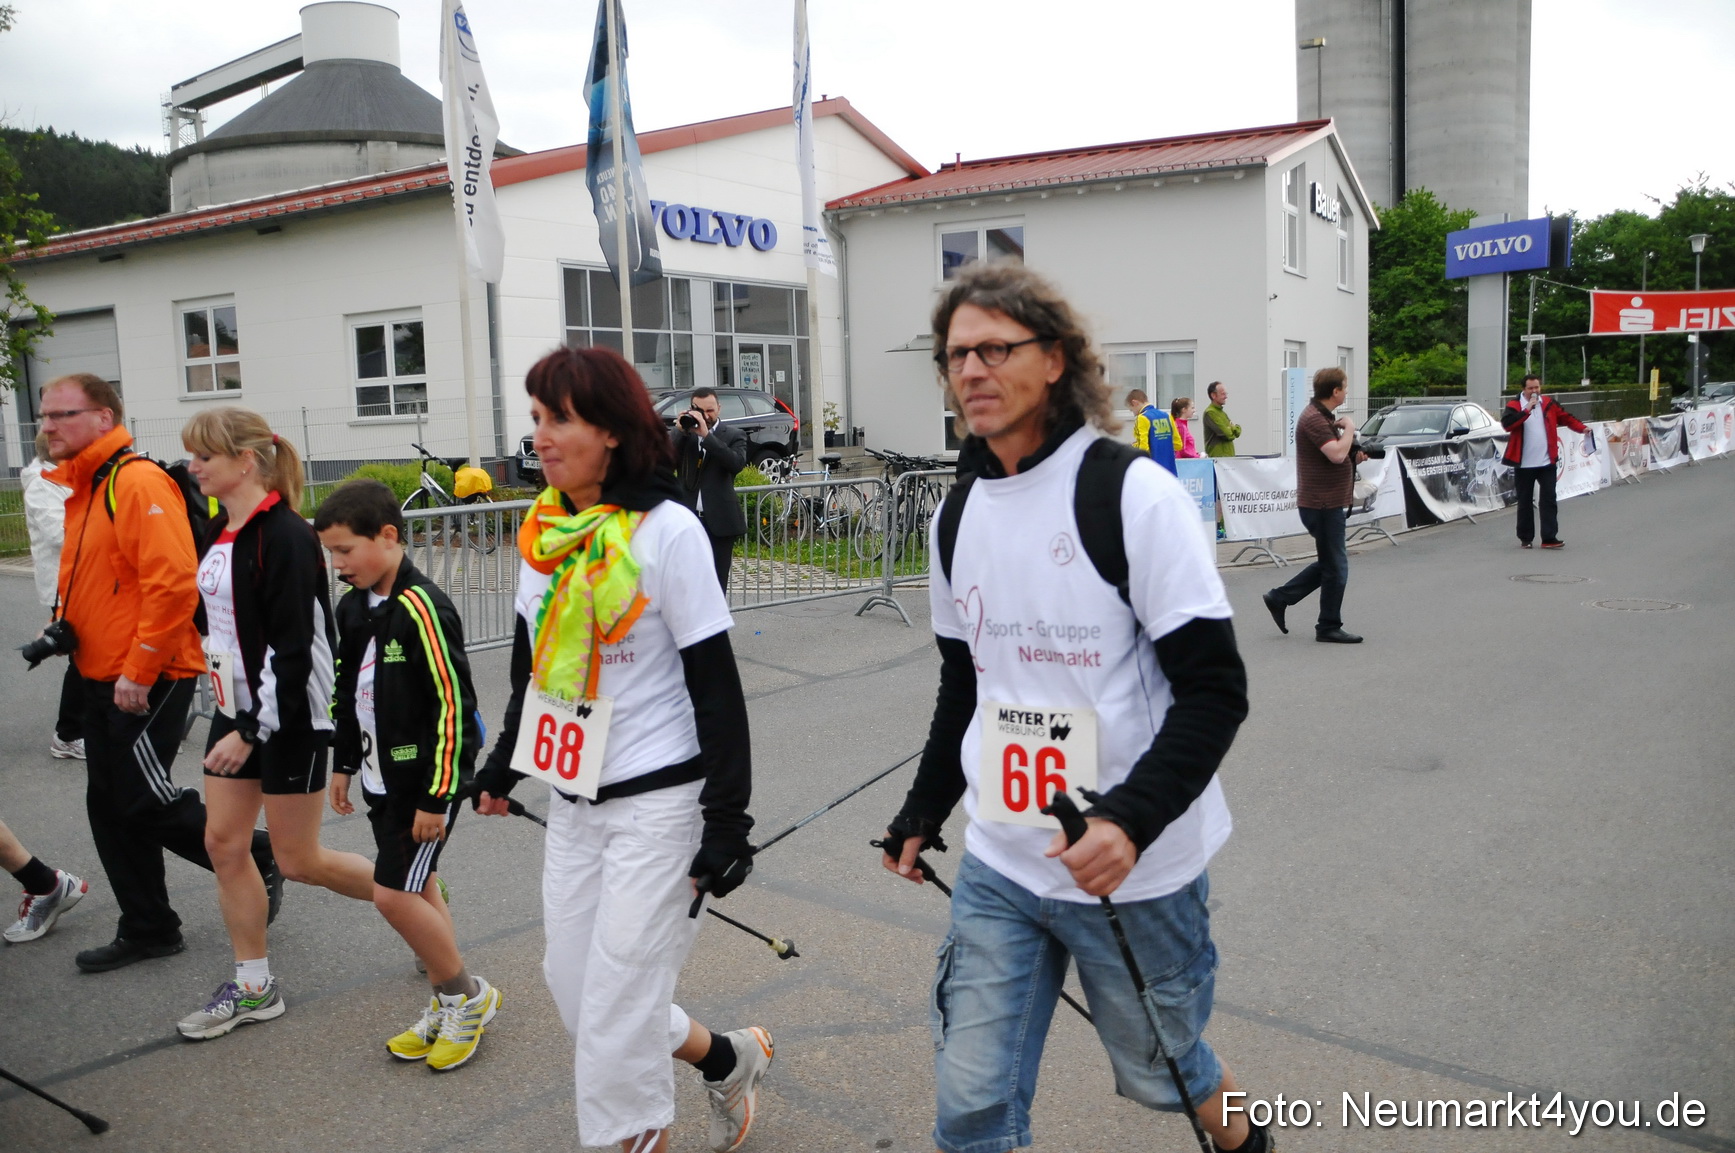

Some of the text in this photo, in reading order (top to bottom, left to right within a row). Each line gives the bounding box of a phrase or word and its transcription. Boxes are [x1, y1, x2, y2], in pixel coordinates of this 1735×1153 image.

[1454, 234, 1533, 262] VOLVO
[1223, 491, 1270, 502] TECHNOLOGIE
[1271, 490, 1289, 500] GANZ
[1237, 503, 1257, 514] NEUE
[1258, 502, 1275, 513] SEAT
[985, 618, 1022, 638] Sport
[1036, 619, 1101, 644] Gruppe
[1018, 645, 1102, 668] Neumarkt
[537, 693, 574, 713] WERBUNG
[998, 708, 1044, 727] MEYER
[998, 722, 1046, 738] WERBUNG
[533, 713, 585, 781] 68
[1002, 742, 1067, 816] 66
